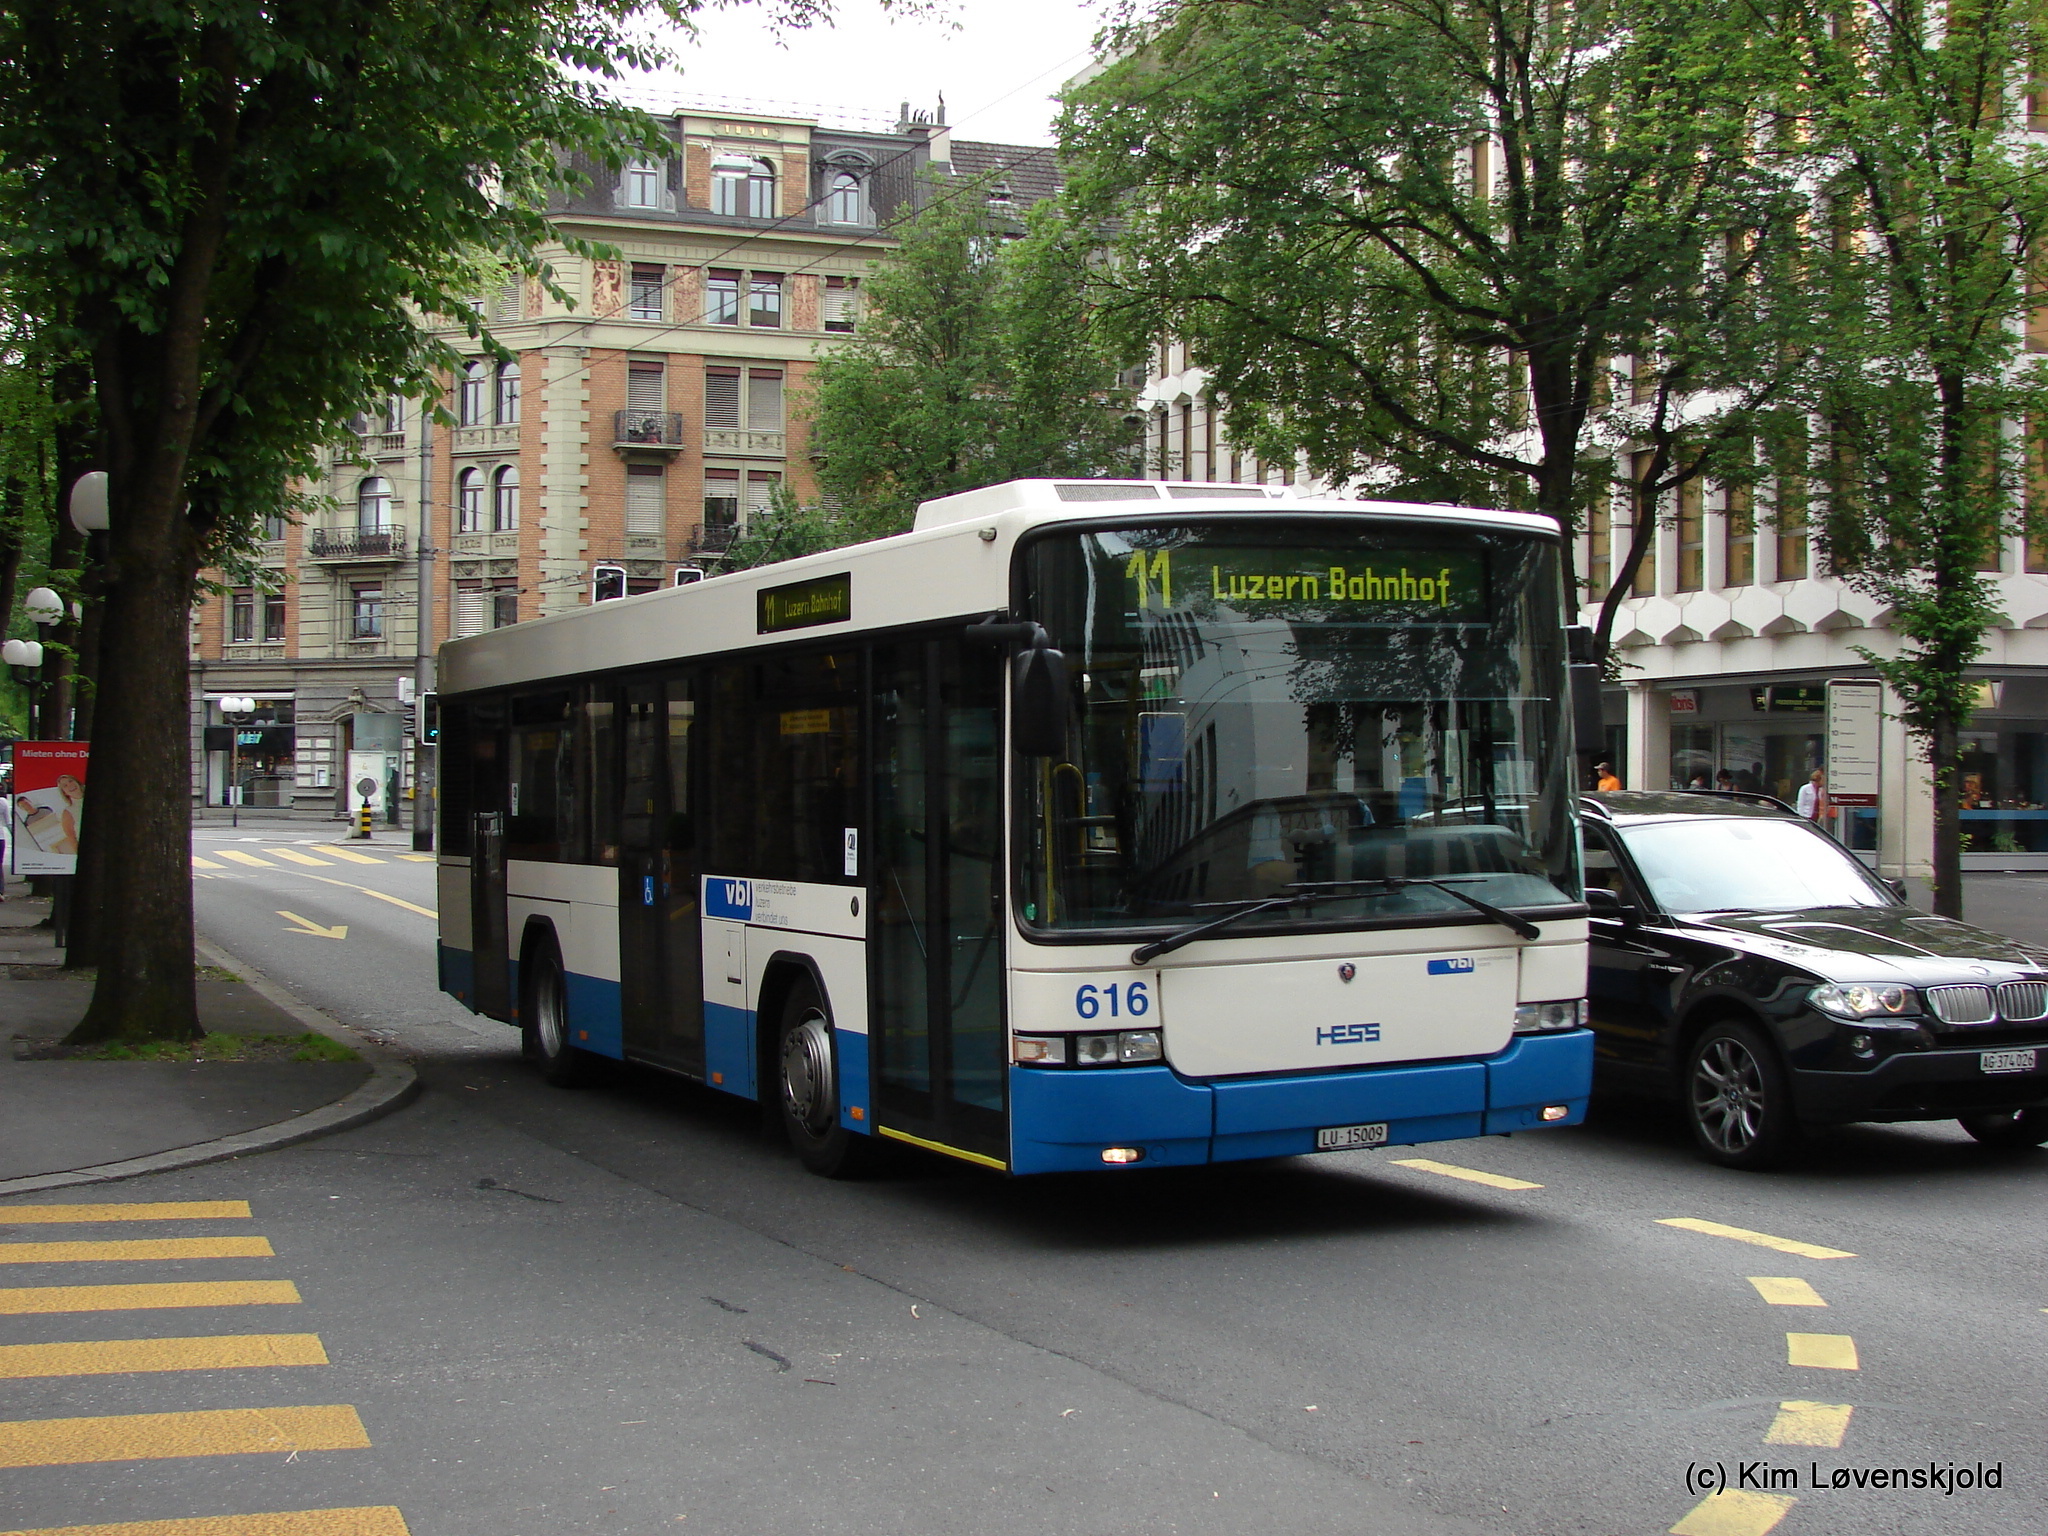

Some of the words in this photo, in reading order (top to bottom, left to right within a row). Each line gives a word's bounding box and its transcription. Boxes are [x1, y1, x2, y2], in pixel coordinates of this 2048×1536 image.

[725, 124, 769, 136] 1890
[1125, 549, 1172, 609] 11
[1212, 565, 1319, 600] Luzern
[1329, 567, 1450, 608] Bahnhof
[784, 600, 810, 618] Luzern
[811, 589, 842, 613] Bahnhof
[22, 749, 53, 758] Mieten
[54, 750, 78, 758] ohne
[725, 879, 751, 907] vbl
[1446, 957, 1474, 969] vbl
[1076, 982, 1149, 1019] 616
[1316, 1022, 1380, 1046] HESS
